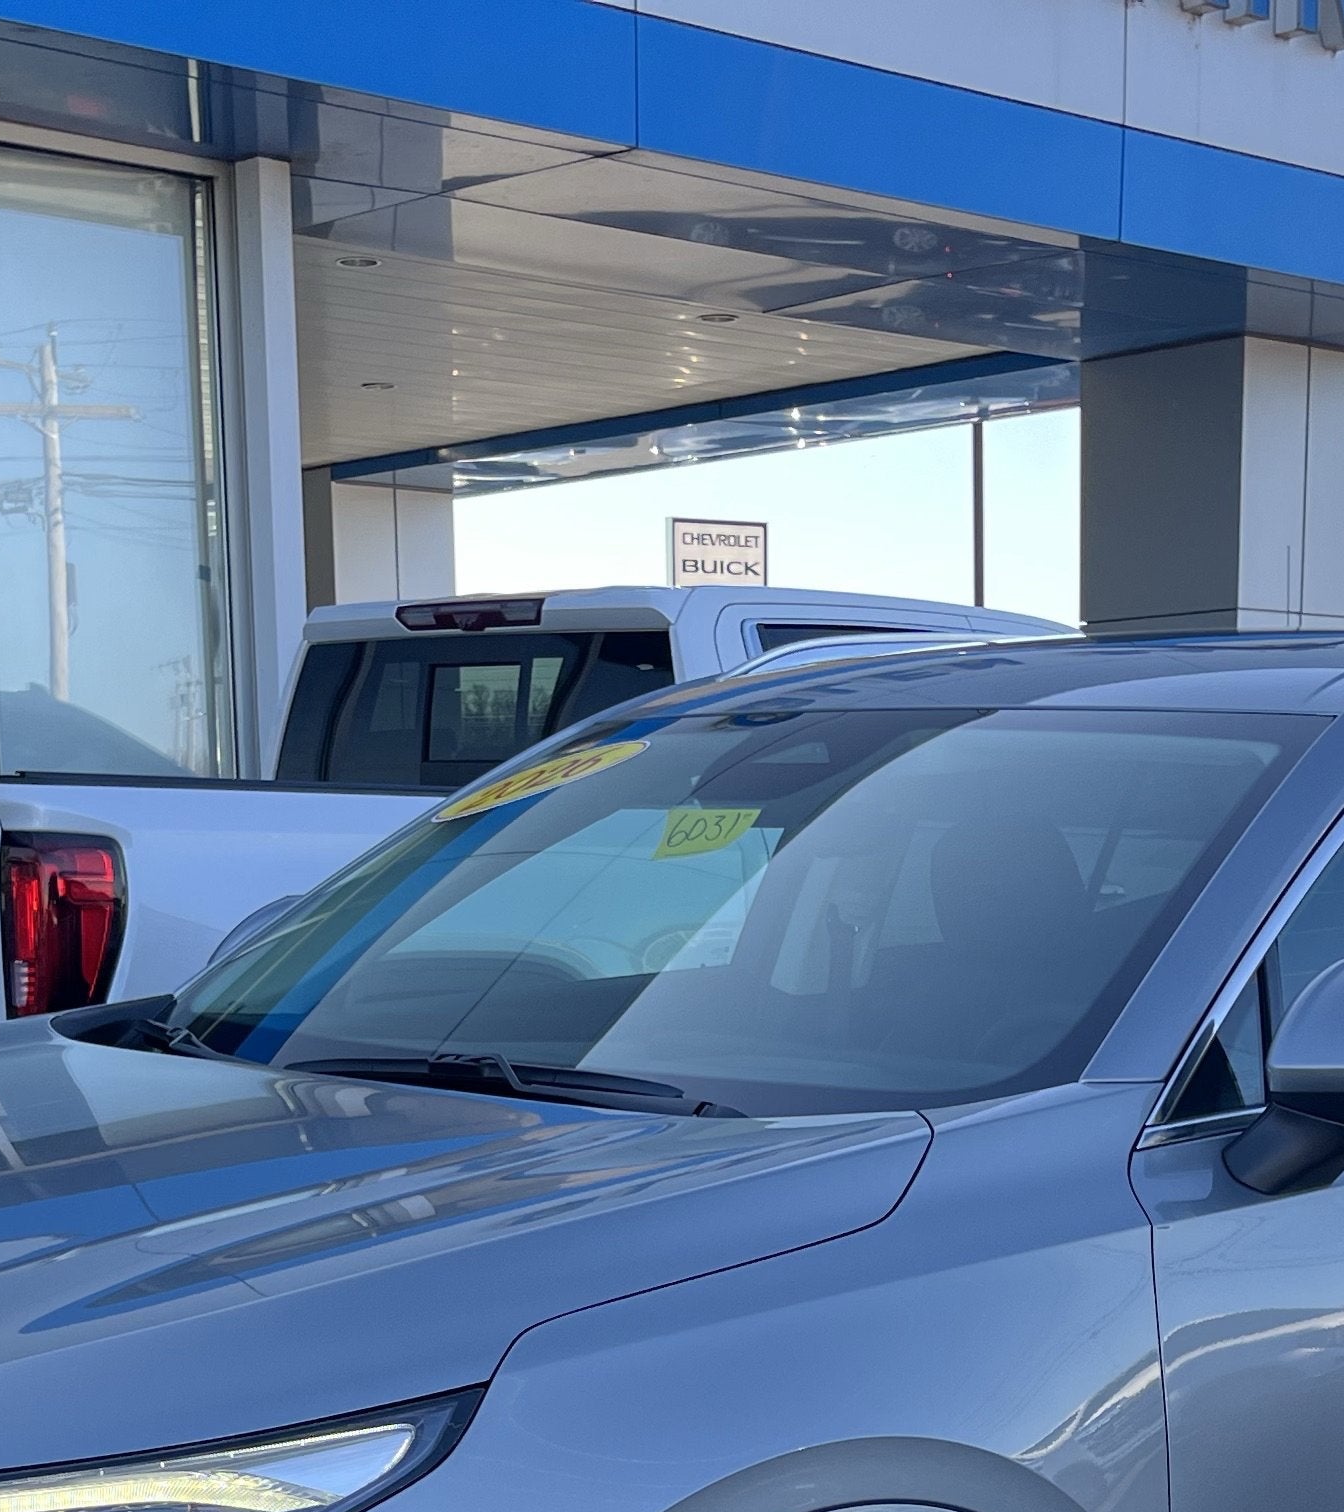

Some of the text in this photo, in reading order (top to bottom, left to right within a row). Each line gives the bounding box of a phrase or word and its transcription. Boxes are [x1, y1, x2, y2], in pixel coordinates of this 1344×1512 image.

[682, 532, 760, 548] CHEVROLET
[682, 558, 761, 576] BUICK
[457, 744, 626, 813] 2026
